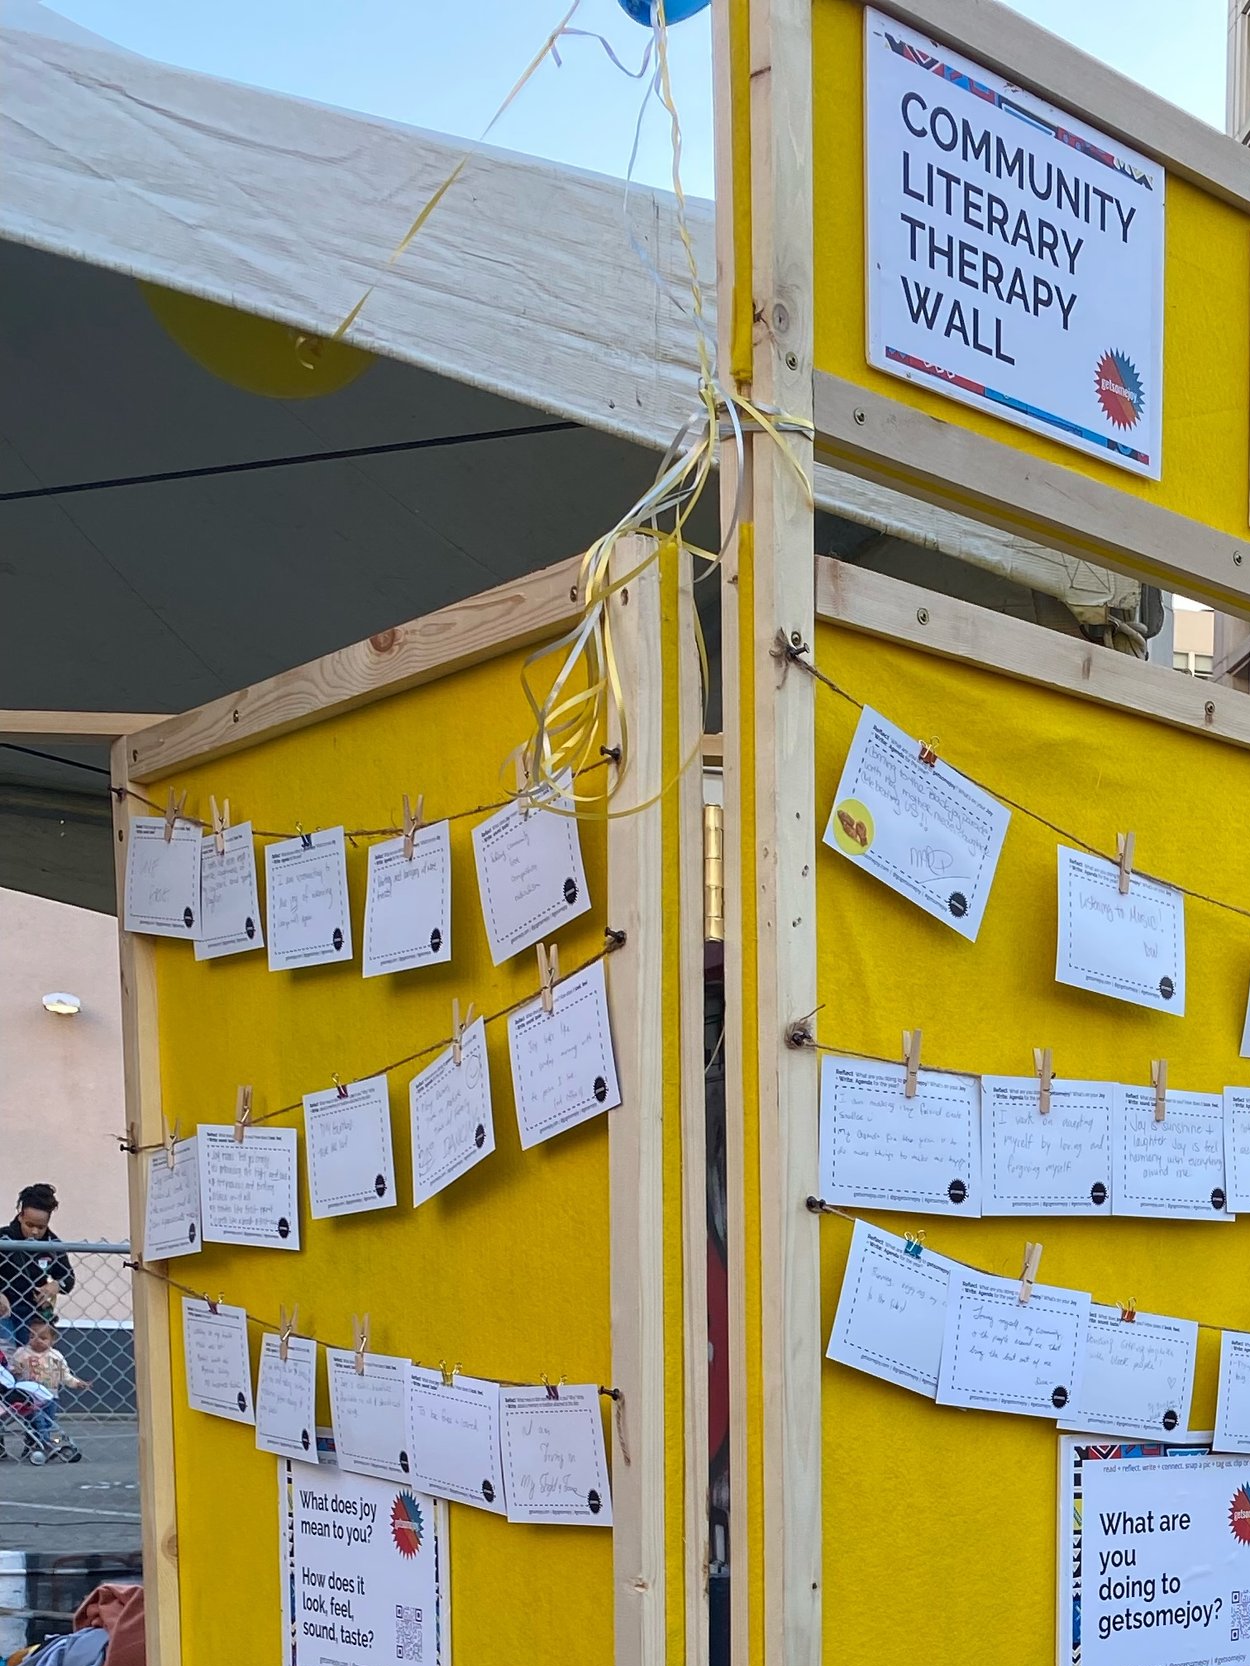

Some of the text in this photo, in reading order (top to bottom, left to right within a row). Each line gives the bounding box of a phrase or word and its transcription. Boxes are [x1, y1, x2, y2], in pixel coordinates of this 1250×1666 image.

[901, 91, 1136, 243] COMMUNITY
[903, 151, 1084, 275] LITERARY
[901, 213, 1077, 331] THERAPY
[901, 276, 1015, 365] WALL
[1101, 378, 1137, 402] getsomejoy
[299, 1490, 377, 1523] What does joy
[301, 1520, 373, 1547] mean to you?
[1099, 1511, 1191, 1535] What are
[1099, 1549, 1136, 1575] you
[302, 1566, 365, 1595] How does it
[1099, 1573, 1181, 1602] doing to
[302, 1591, 354, 1622] look, feel,
[1099, 1598, 1223, 1639] getsomejoy?
[303, 1621, 374, 1648] sound, taste?
